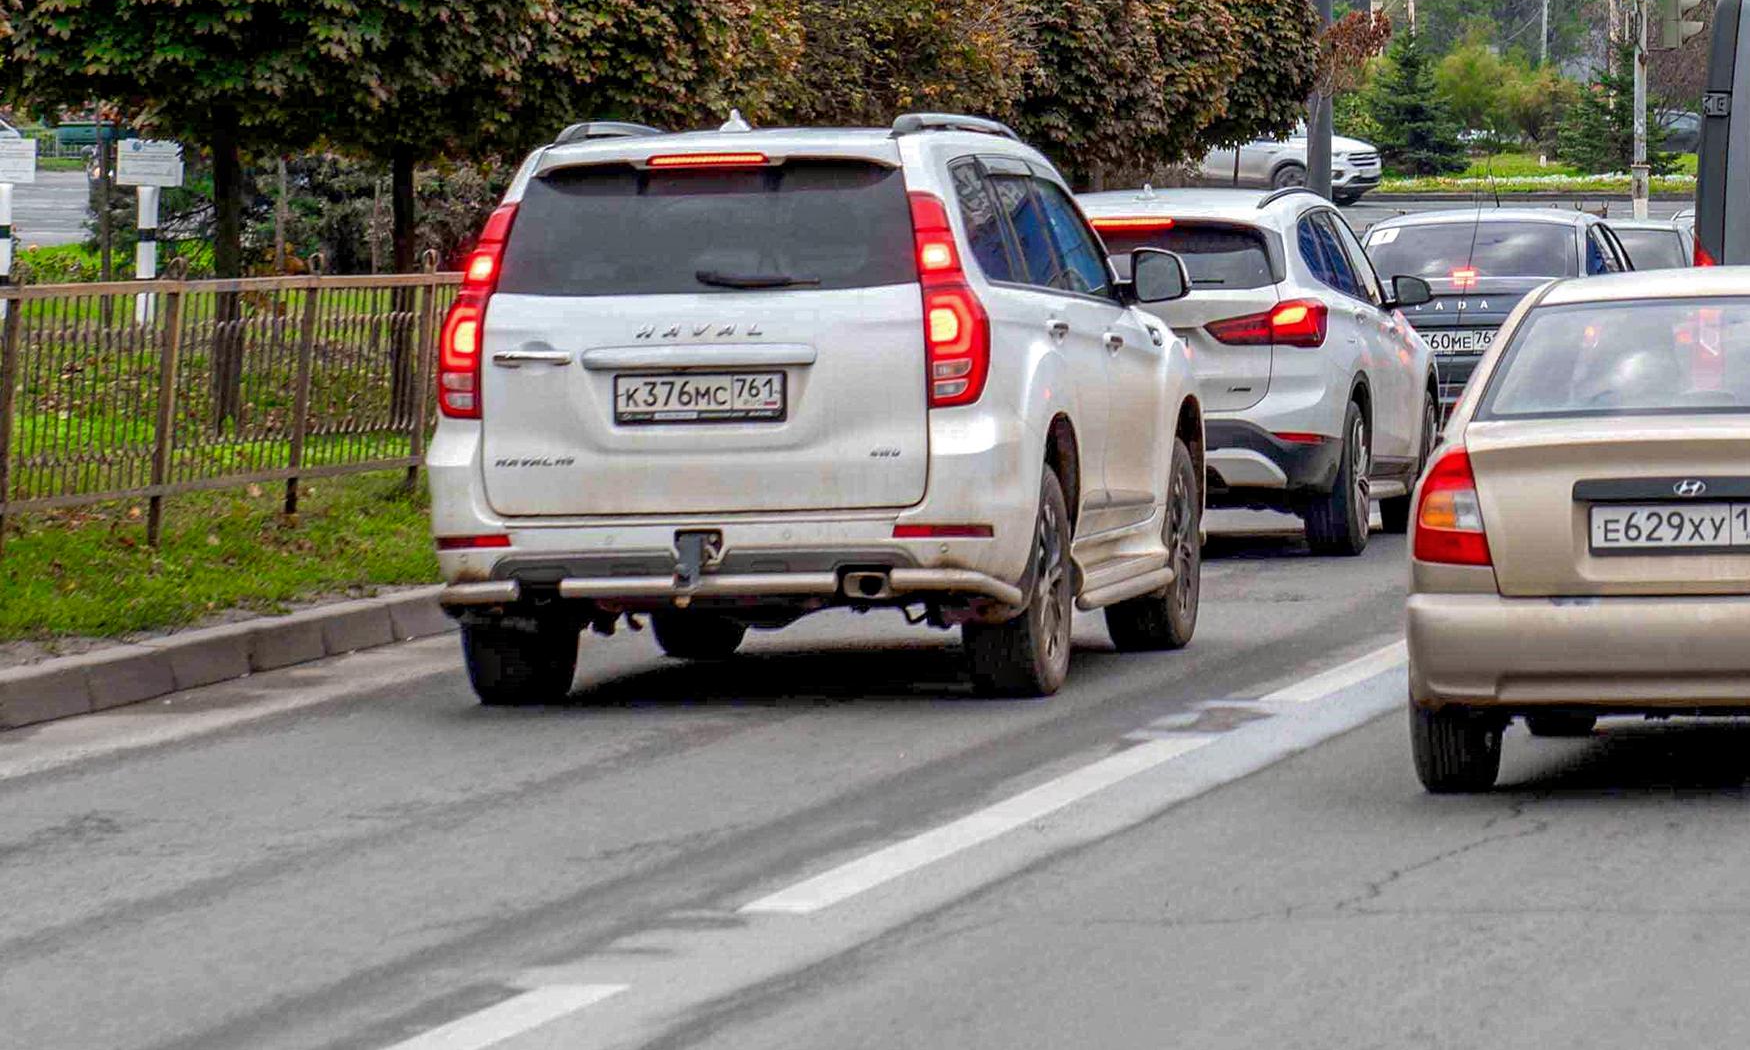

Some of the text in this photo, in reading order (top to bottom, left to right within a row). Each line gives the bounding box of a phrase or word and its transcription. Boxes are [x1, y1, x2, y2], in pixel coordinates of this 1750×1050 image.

[1415, 299, 1489, 311] LADA
[635, 323, 764, 339] HAVAL
[625, 378, 774, 408] К376МС 761
[1603, 511, 1726, 543] Е629ХУ
